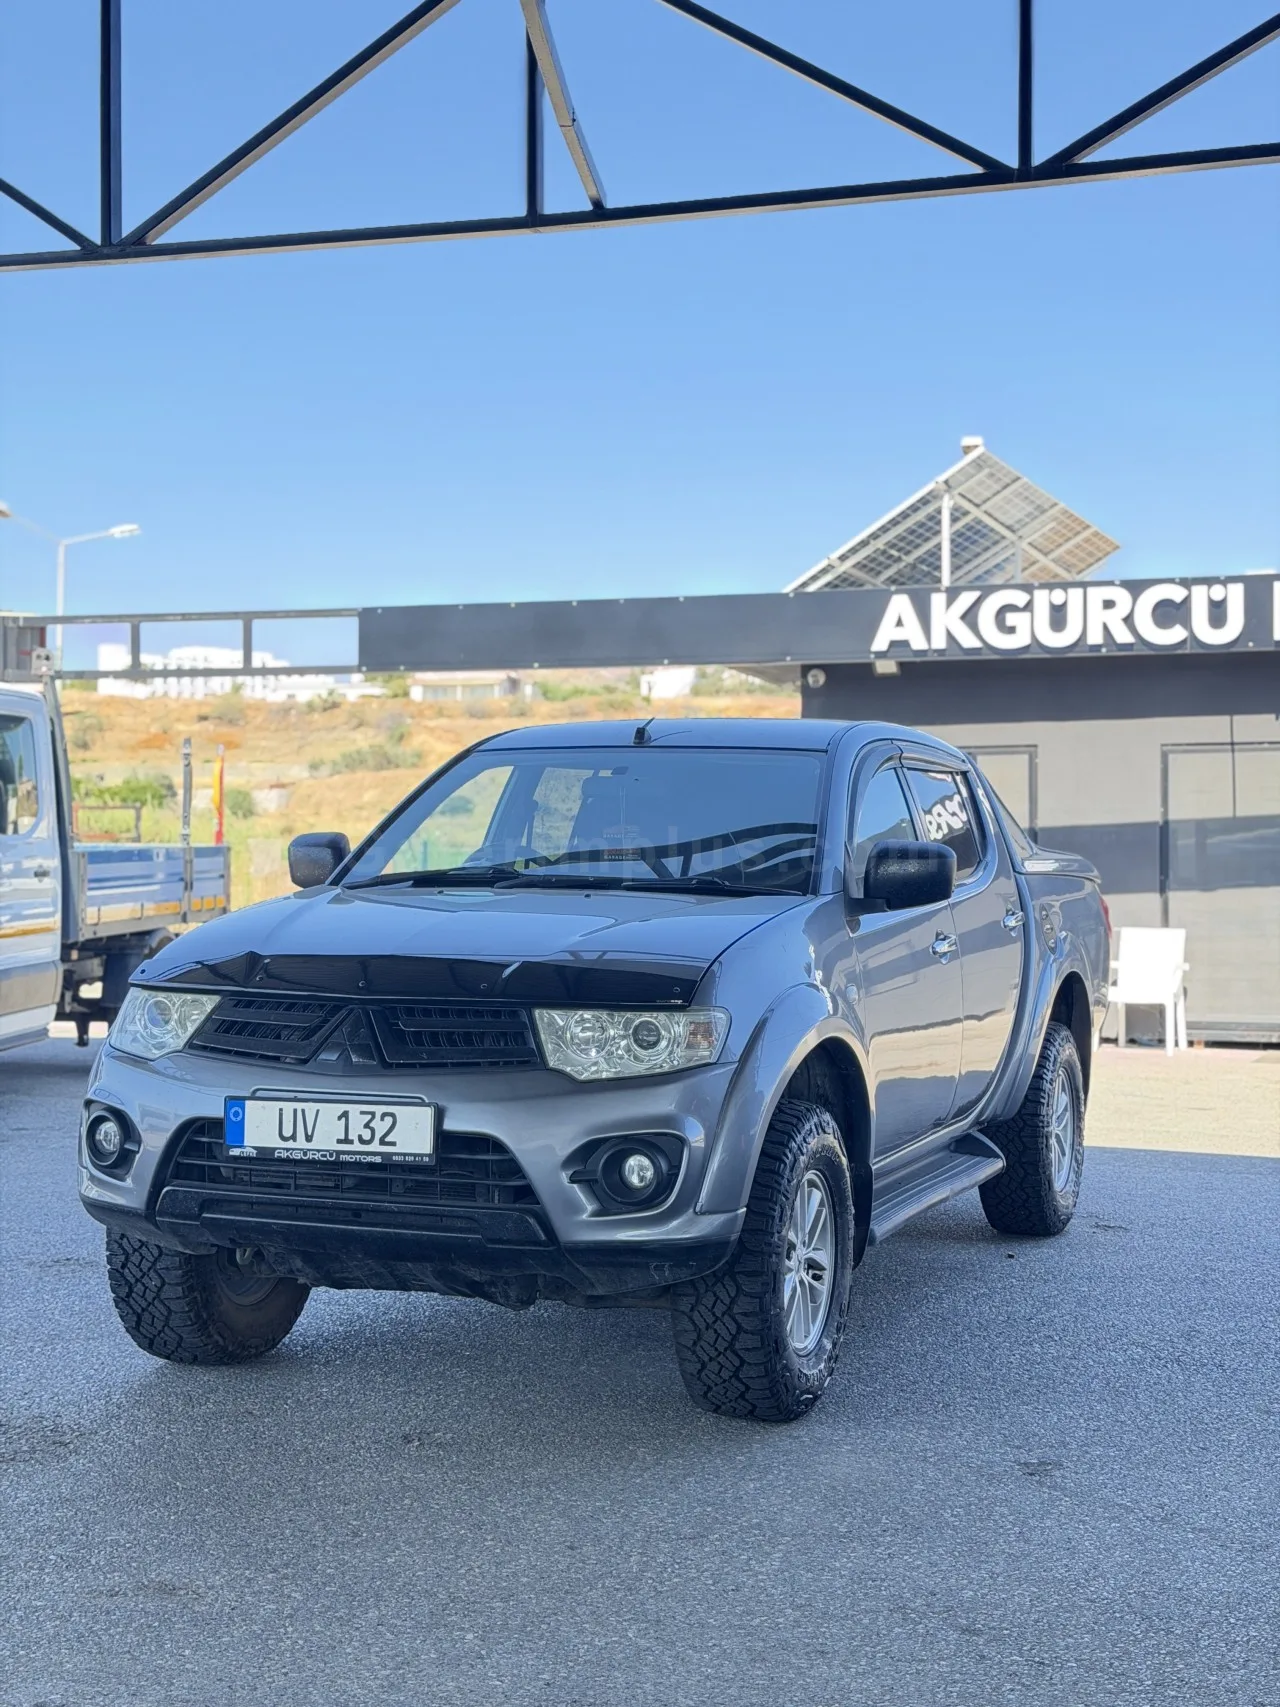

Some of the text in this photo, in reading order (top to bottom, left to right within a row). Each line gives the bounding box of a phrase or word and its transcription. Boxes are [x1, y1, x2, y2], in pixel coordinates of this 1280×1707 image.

[869, 583, 1245, 652] AKGÜRCÜ
[277, 1107, 398, 1147] UV 132
[274, 1149, 382, 1163] AKGÜRCÜ MOTORS
